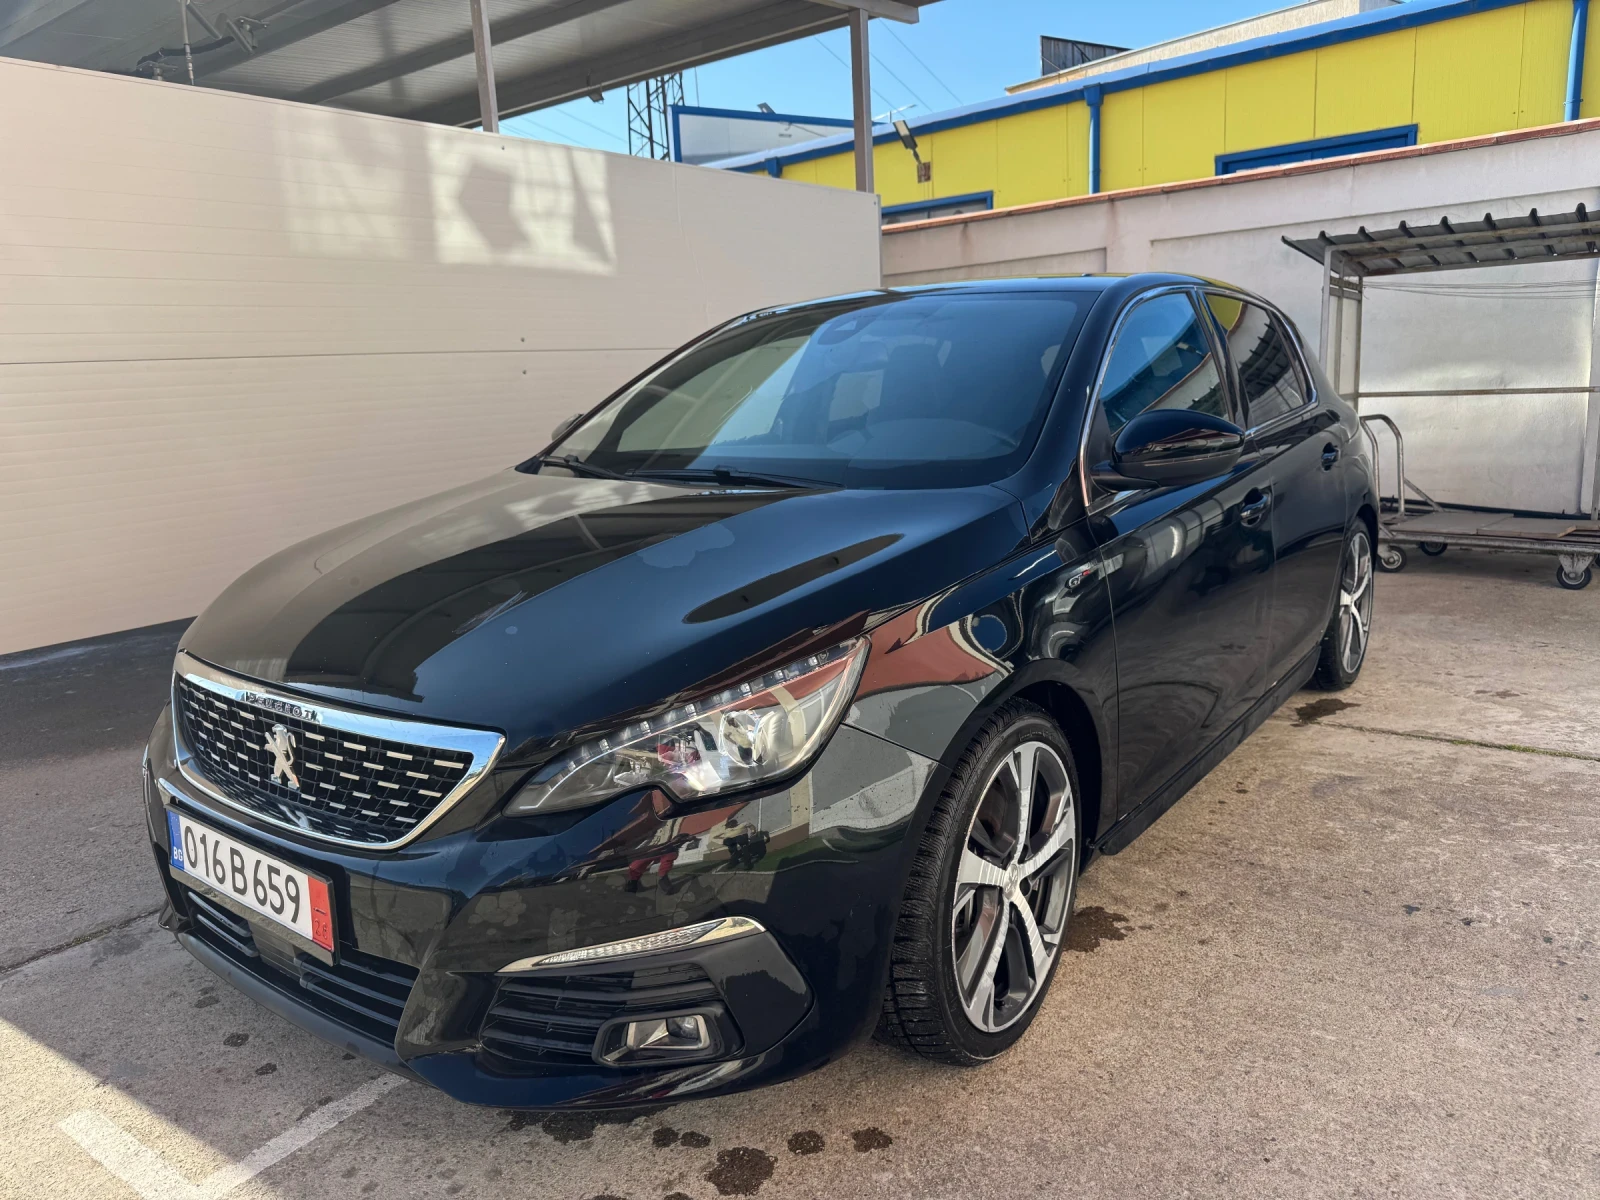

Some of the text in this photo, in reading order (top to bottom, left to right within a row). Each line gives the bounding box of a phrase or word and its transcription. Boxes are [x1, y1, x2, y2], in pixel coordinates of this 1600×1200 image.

[246, 691, 315, 720] PEUGEOT
[173, 848, 184, 862] BG
[184, 825, 300, 924] 016B659
